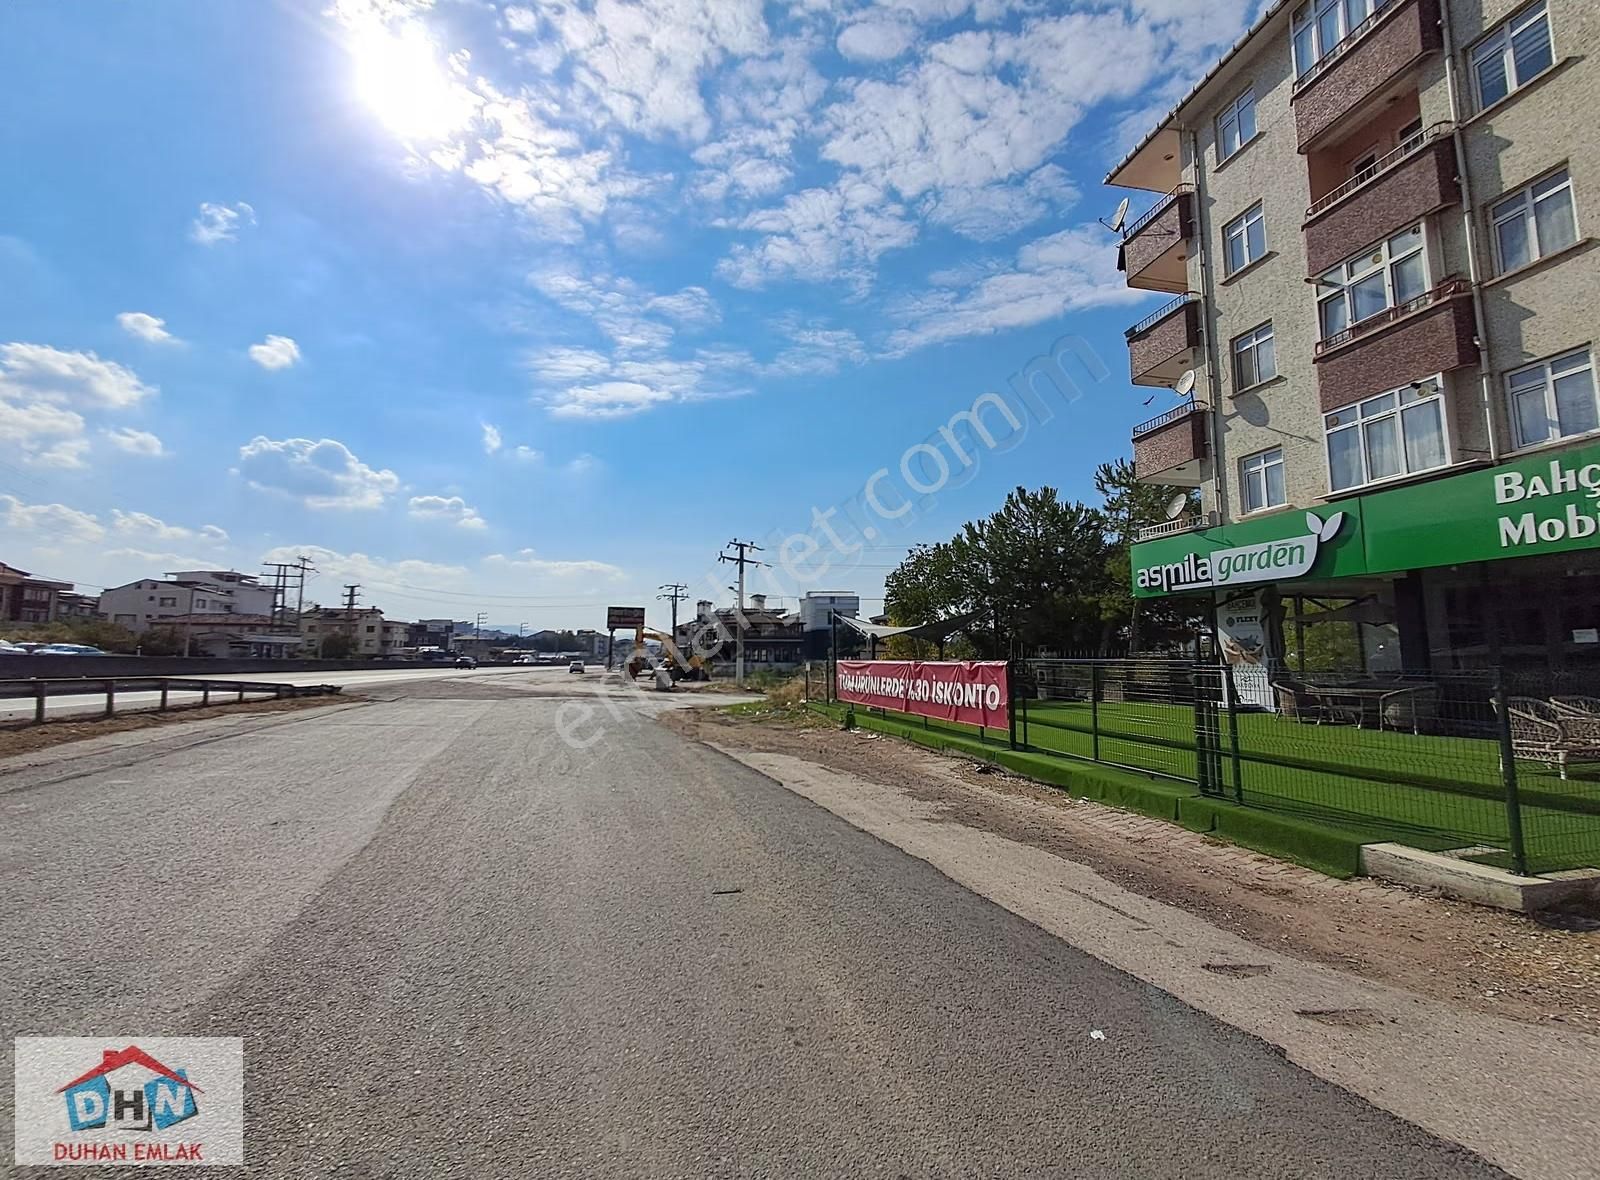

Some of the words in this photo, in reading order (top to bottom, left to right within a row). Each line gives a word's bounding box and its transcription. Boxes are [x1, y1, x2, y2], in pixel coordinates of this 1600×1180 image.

[1136, 552, 1212, 592] asmila
[1217, 543, 1304, 582] garden
[855, 670, 905, 699] ÜRÜNLERDE
[904, 678, 930, 702] %30
[931, 674, 1001, 711] İSKONTO
